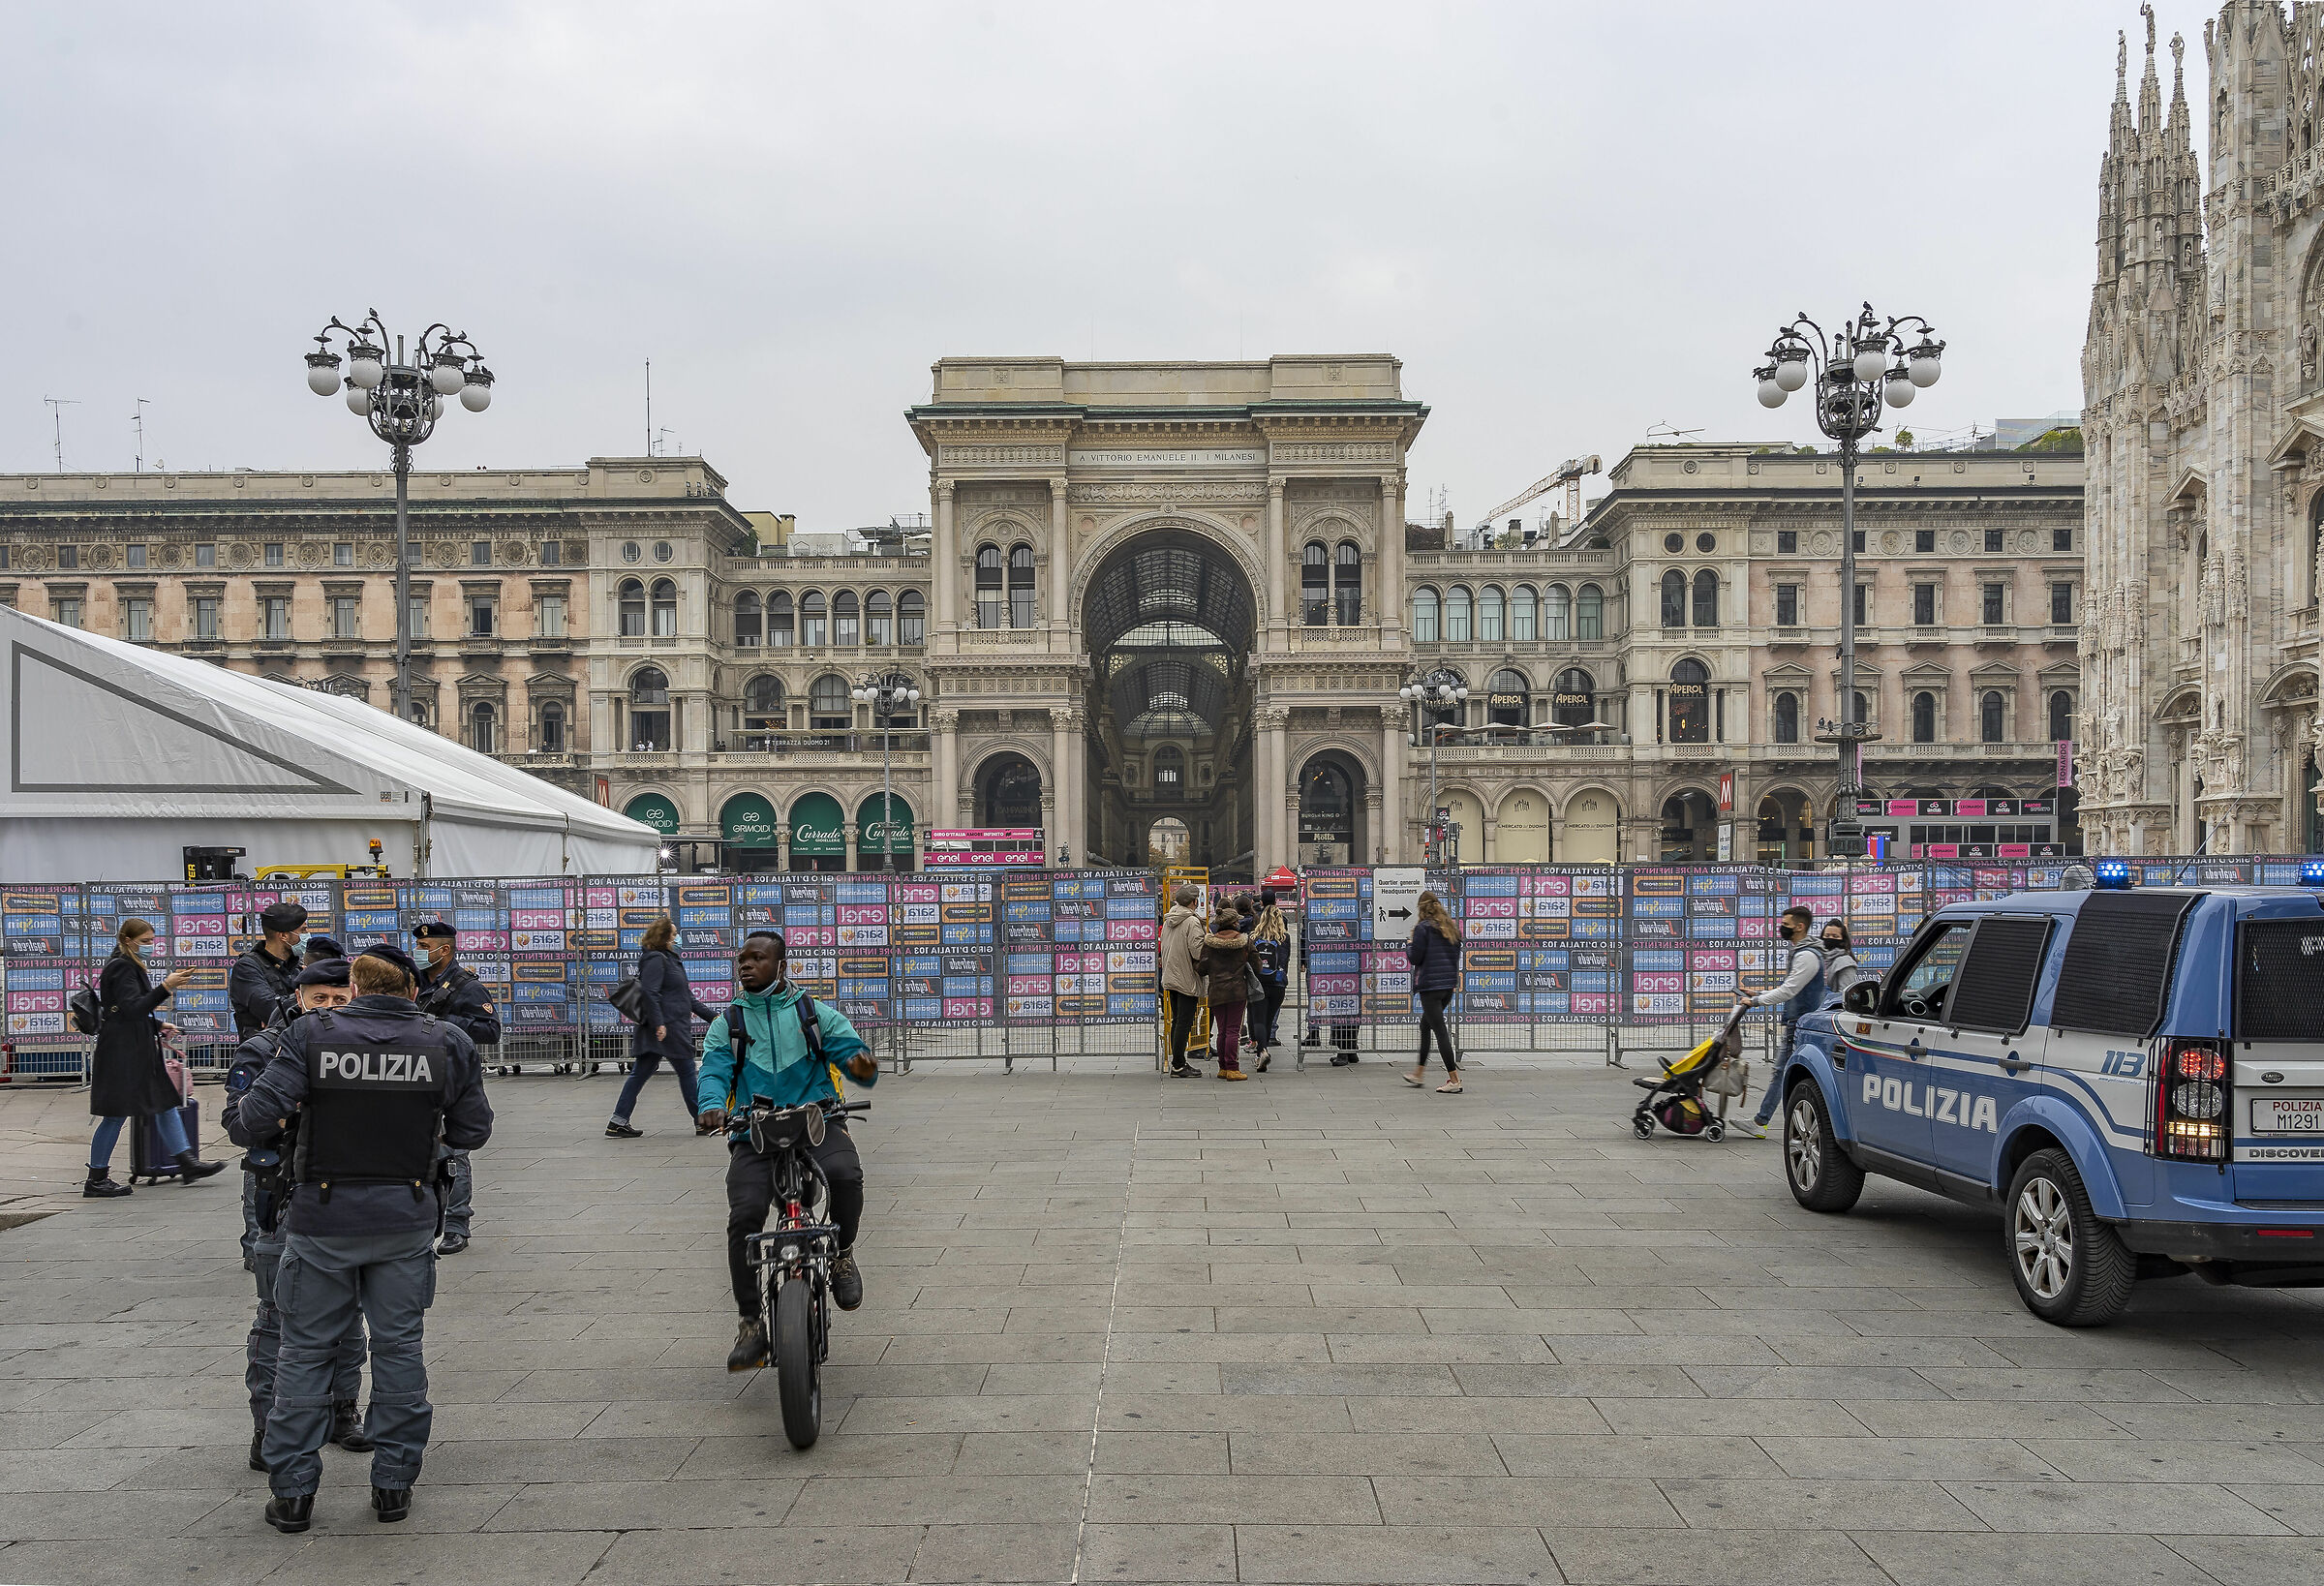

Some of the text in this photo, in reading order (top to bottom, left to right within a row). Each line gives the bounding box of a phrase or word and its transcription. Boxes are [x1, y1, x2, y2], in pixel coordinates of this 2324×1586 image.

[1670, 684, 1703, 693] APEROL
[1491, 693, 1523, 704] APEROL
[1556, 693, 1588, 704] APEROL
[1721, 780, 1731, 804] M
[796, 824, 841, 842] Currado
[866, 822, 909, 840] Curado
[937, 853, 961, 862] enel
[971, 853, 994, 862] enel
[1005, 853, 1028, 862] enel
[320, 1052, 432, 1083] POLIZIA
[2100, 1050, 2146, 1078] 113
[1862, 1073, 1999, 1133] POLIZIA
[2273, 1102, 2322, 1112] POLIZIA
[2278, 1114, 2319, 1129] M1291
